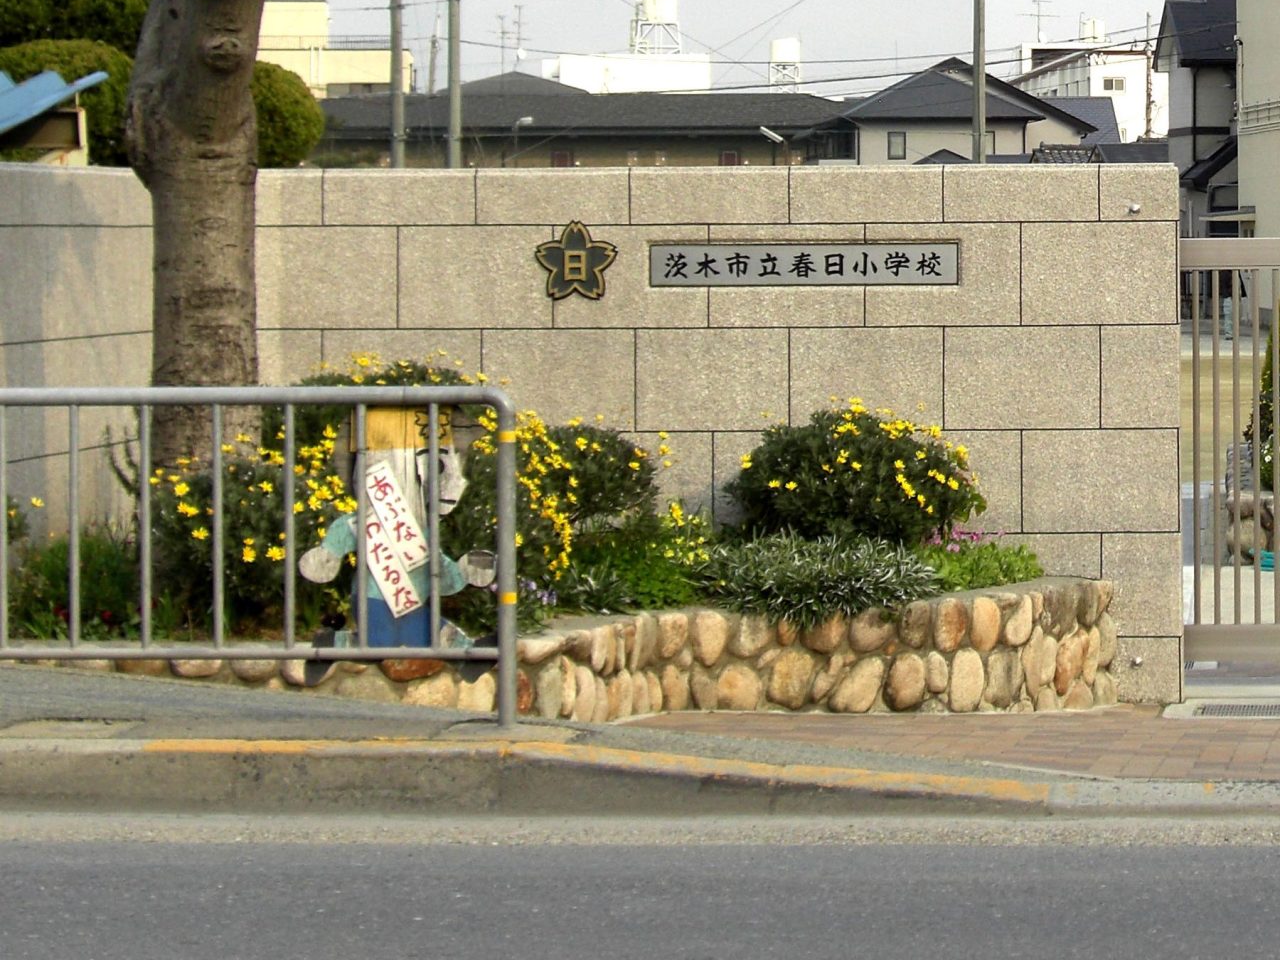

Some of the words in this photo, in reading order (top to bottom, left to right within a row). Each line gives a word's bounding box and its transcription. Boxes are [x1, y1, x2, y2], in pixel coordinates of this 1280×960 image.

[563, 250, 587, 282] 日
[664, 251, 943, 279] 茨木市立春日小学校
[368, 475, 427, 561] あぶない
